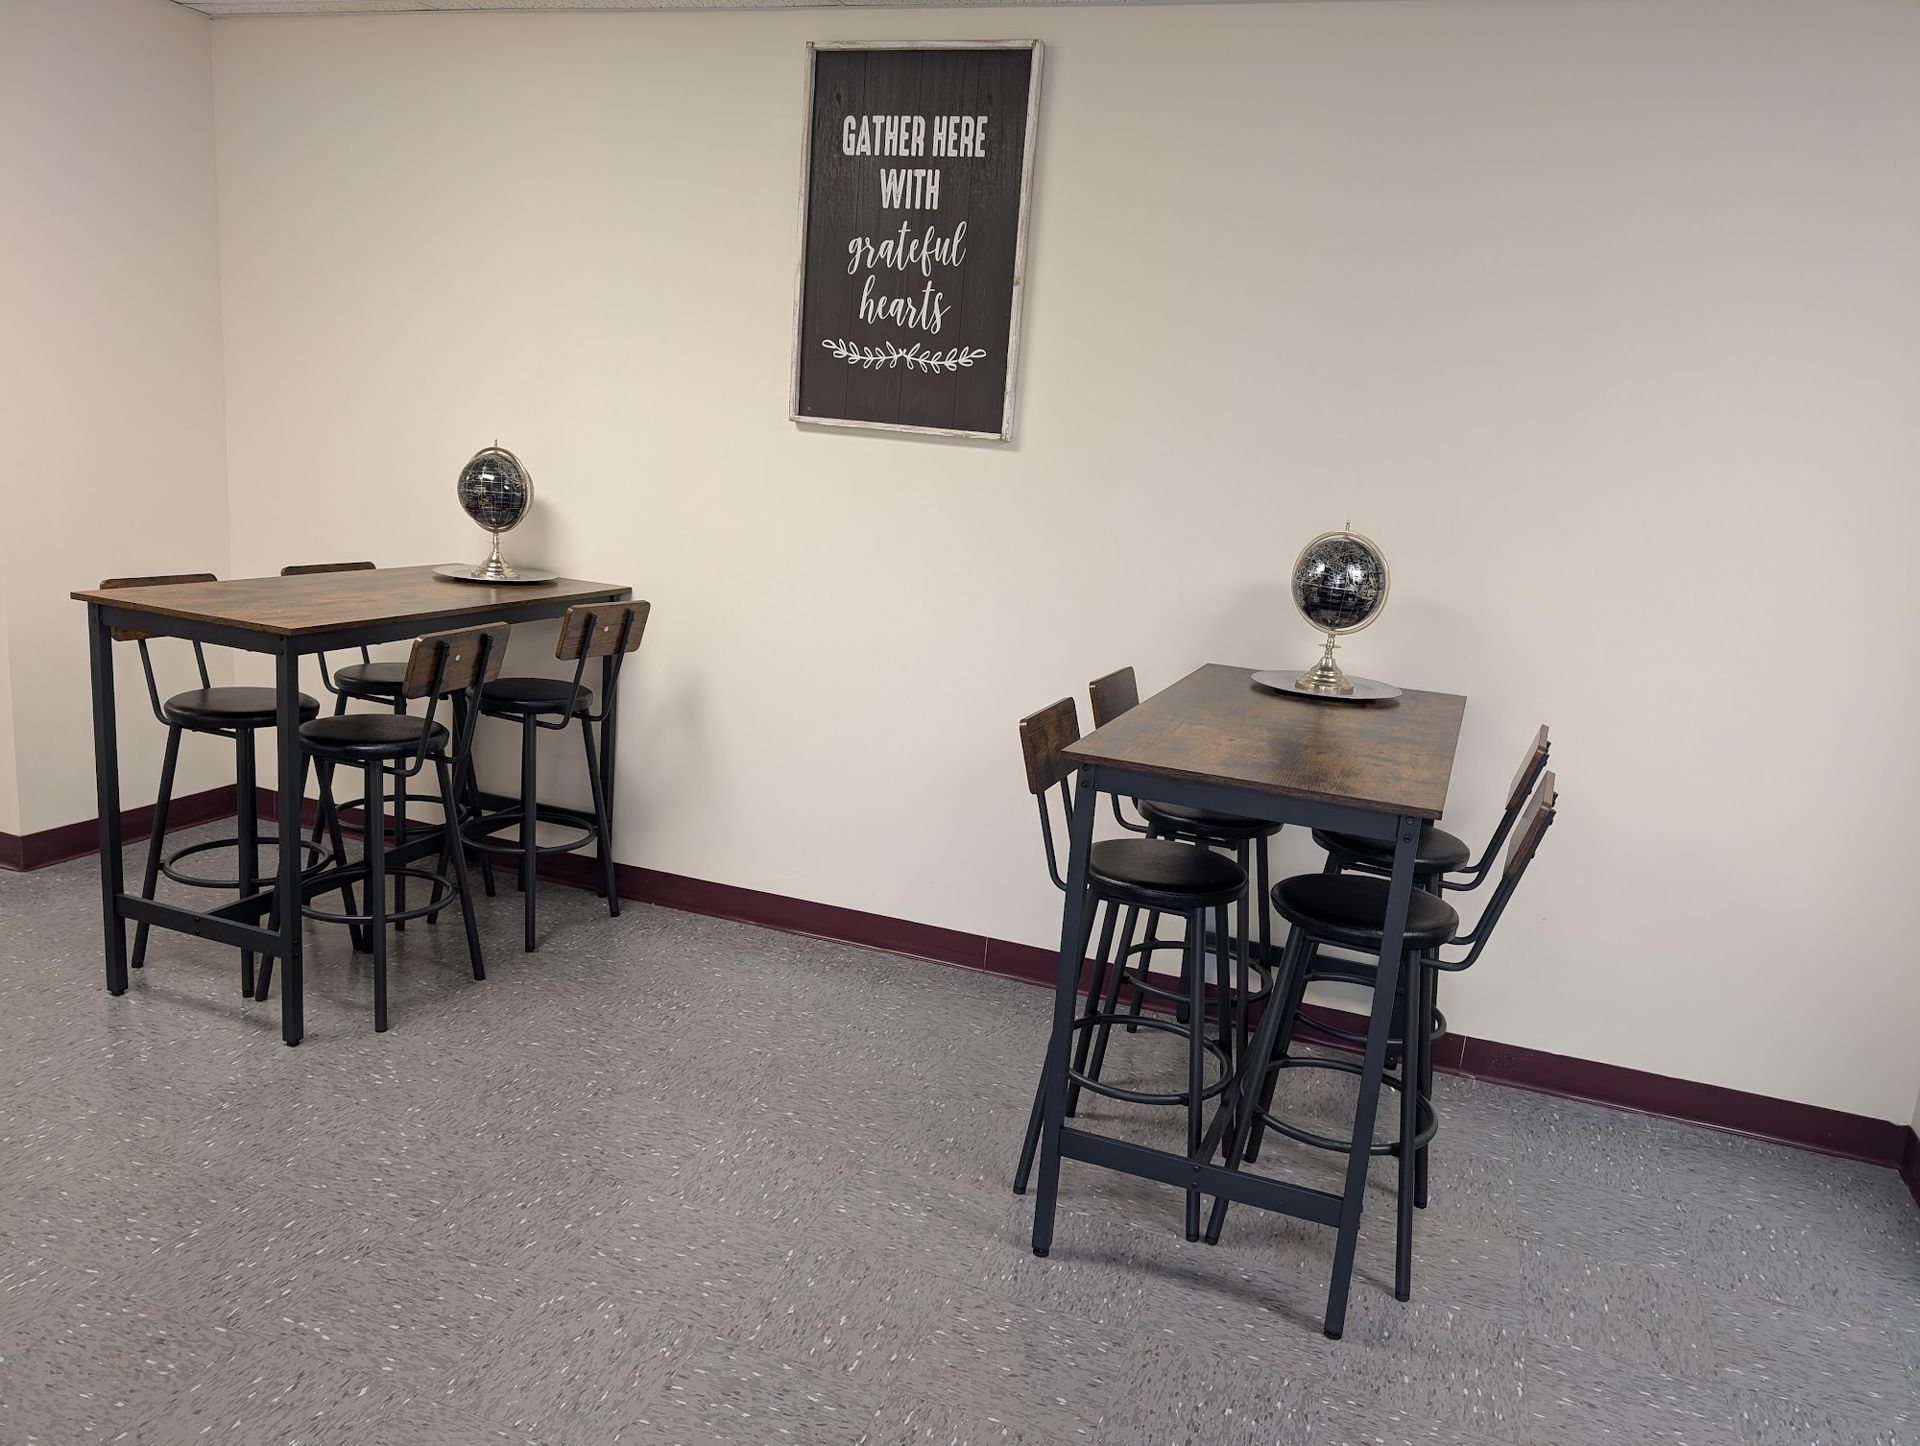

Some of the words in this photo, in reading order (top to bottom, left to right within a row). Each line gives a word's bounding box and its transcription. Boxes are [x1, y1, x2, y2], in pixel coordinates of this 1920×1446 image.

[842, 115, 926, 157] GATHER
[932, 115, 988, 158] HERE
[879, 168, 941, 210] WITH
[847, 220, 967, 277] grateful
[859, 274, 952, 335] hearts
